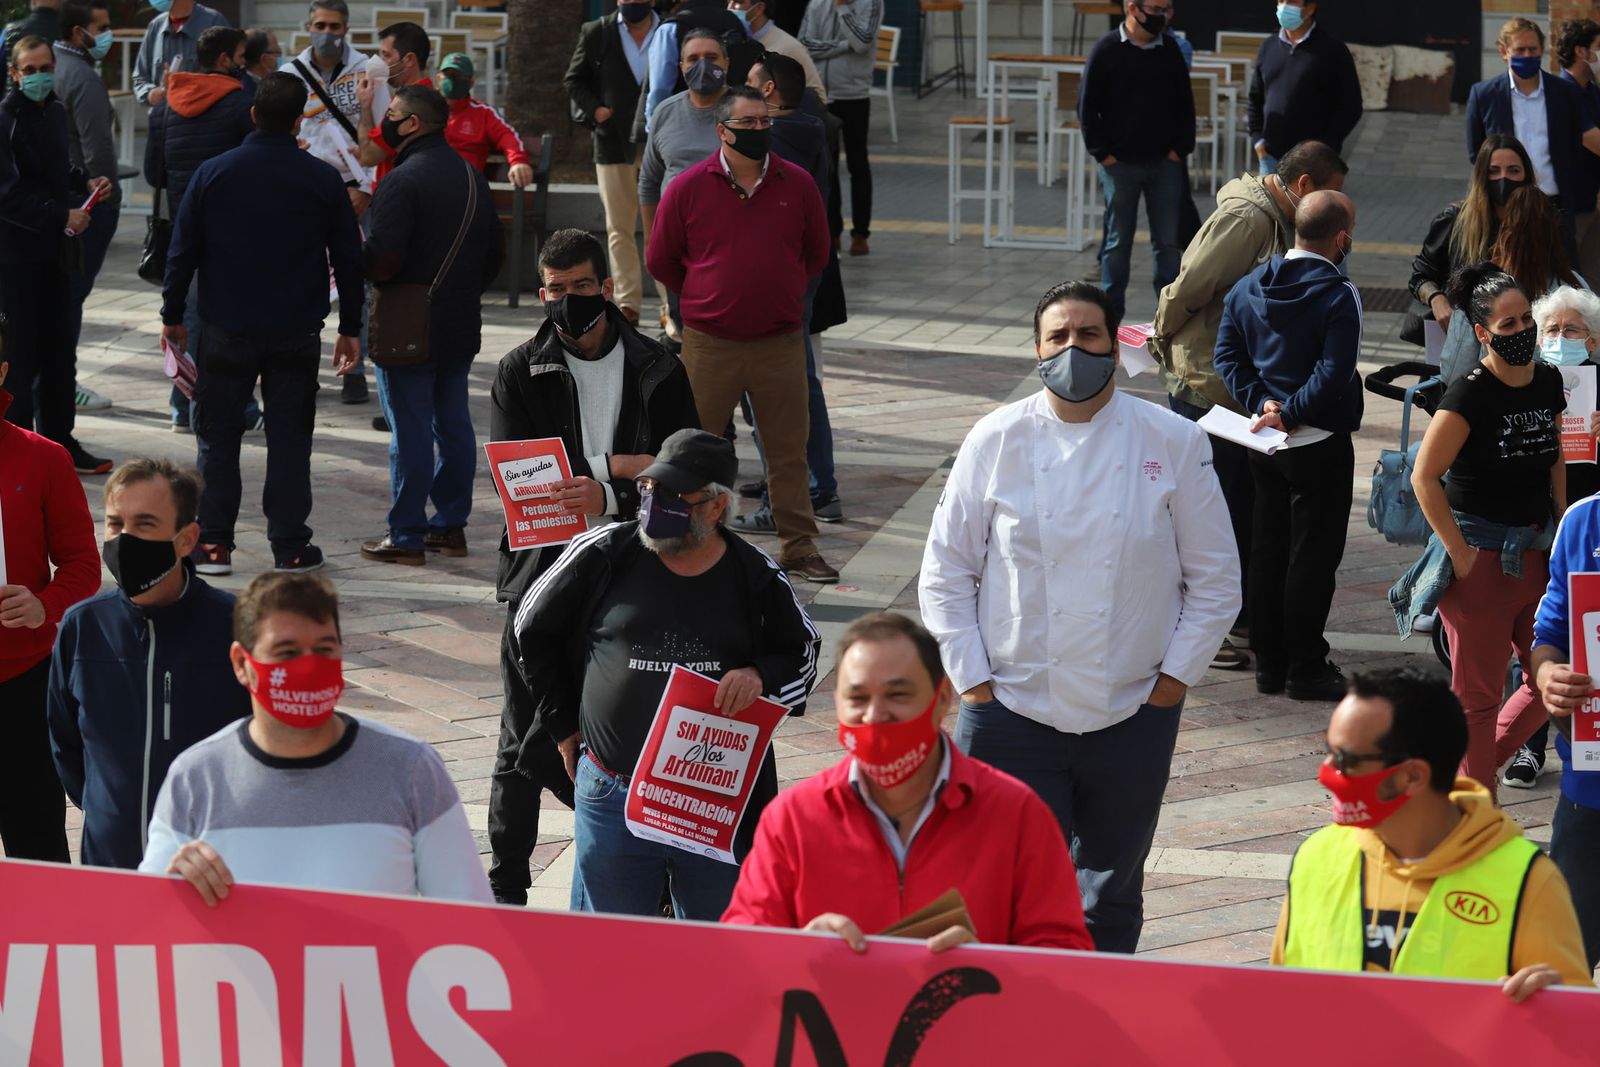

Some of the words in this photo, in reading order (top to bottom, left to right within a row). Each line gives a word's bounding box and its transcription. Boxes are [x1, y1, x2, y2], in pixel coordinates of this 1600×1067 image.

[1502, 408, 1552, 427] YOUNG
[504, 469, 521, 481] Sin
[521, 461, 554, 478] ayudas
[515, 520, 531, 532] las
[532, 514, 579, 530] molestias
[628, 658, 676, 673] HUELV
[685, 661, 721, 672] YORK
[676, 720, 701, 742] SIN
[700, 726, 749, 752] AYUDAS
[683, 742, 726, 763] Nos
[662, 754, 740, 789] Arruinan!
[636, 780, 736, 826] CONCENTRACIÓN
[644, 817, 661, 827] LUGAR:
[661, 822, 677, 833] PLAZA
[684, 829, 695, 839] LAS
[694, 832, 715, 844] MONJAS
[667, 814, 698, 831] NOVIEMBRE
[1453, 896, 1489, 920] KIA
